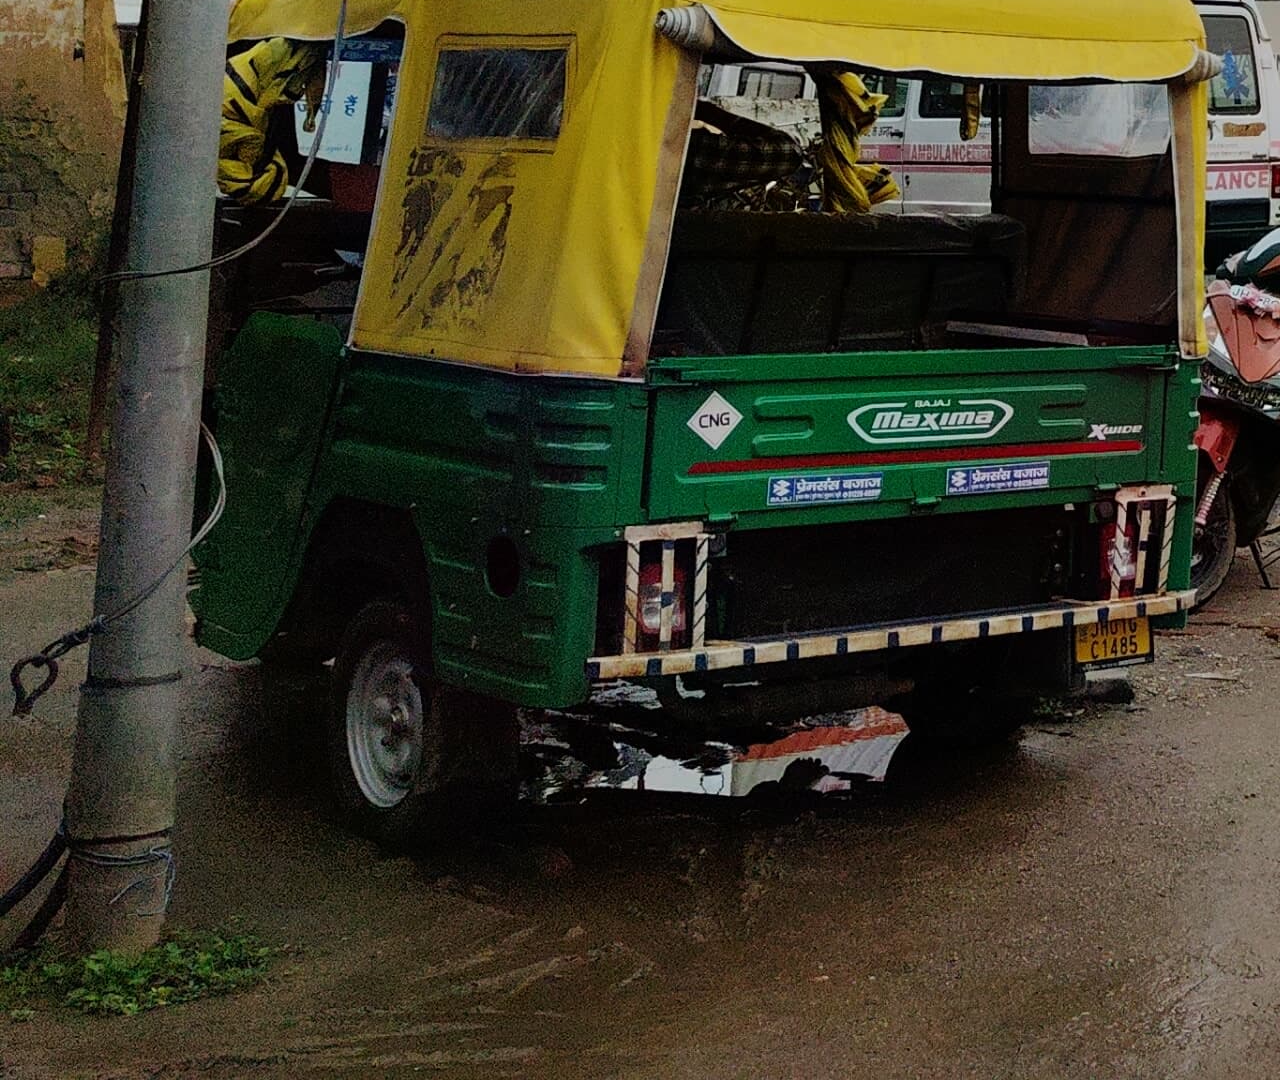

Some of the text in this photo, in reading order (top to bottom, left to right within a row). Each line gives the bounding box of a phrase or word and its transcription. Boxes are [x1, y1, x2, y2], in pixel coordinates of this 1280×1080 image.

[1205, 171, 1270, 193] LANCE
[914, 399, 951, 409] BAJAJ
[698, 411, 731, 429] CNG
[1012, 466, 1049, 479] बजाज
[842, 477, 881, 490] बजाज
[1090, 634, 1138, 660] C1485
